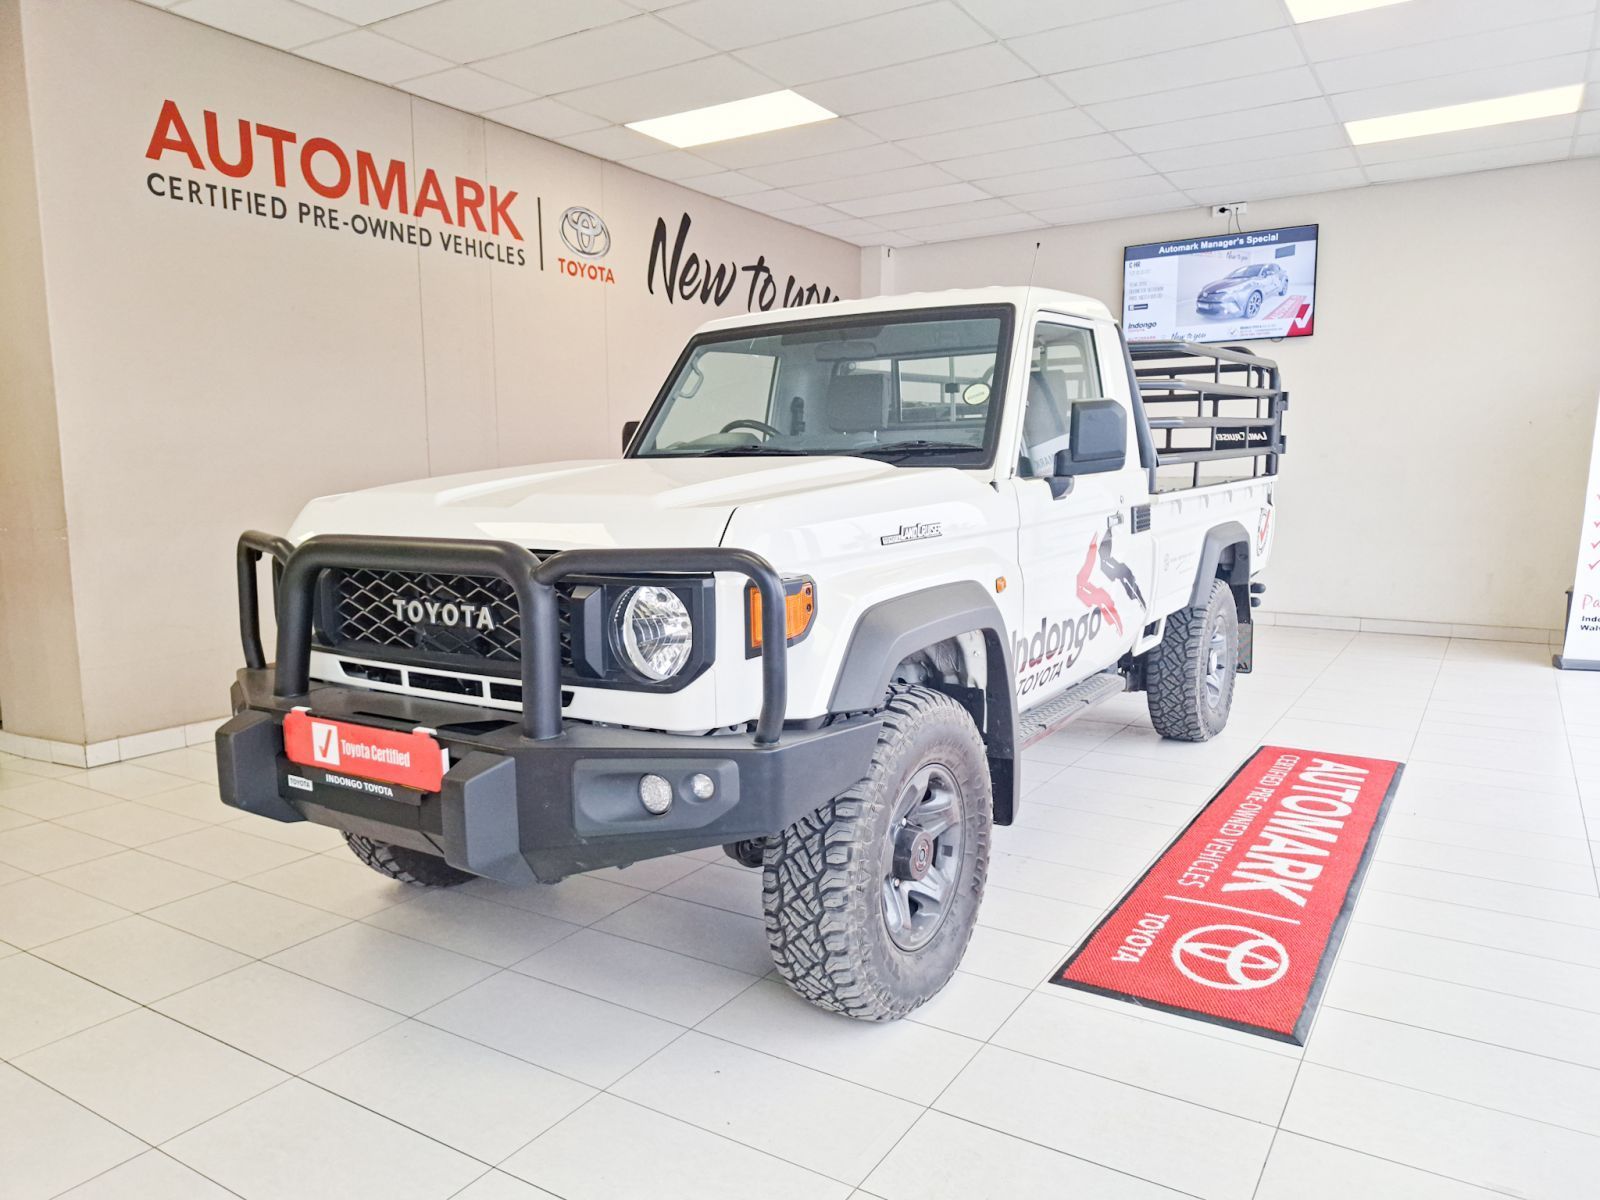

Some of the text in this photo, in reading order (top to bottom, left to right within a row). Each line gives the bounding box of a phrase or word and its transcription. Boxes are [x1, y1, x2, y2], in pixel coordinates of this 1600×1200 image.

[145, 100, 524, 241] AUTOMARK
[147, 172, 525, 266] CERTIFIED PRE-OWNED VEHICLES
[1159, 242, 1199, 254] Automark
[1201, 237, 1244, 249] Manager's
[1246, 233, 1278, 245] Special
[558, 258, 615, 284] TOYOTA
[648, 212, 736, 306] New
[742, 256, 776, 312] to
[1128, 321, 1157, 329] Indongo
[392, 599, 496, 631] TOYOTA
[1012, 607, 1101, 677] Indongo
[1016, 661, 1063, 696] TOYOTA
[341, 739, 411, 768] Toyota Certified
[289, 777, 311, 788] TOYOTA
[325, 774, 394, 797] INDONGO TOYOTA
[1178, 754, 1300, 888] CERTIFIED PRE-OWNED VEHICLES
[1220, 758, 1370, 907] AUTOMARK
[1112, 912, 1170, 963] TOYOTA
